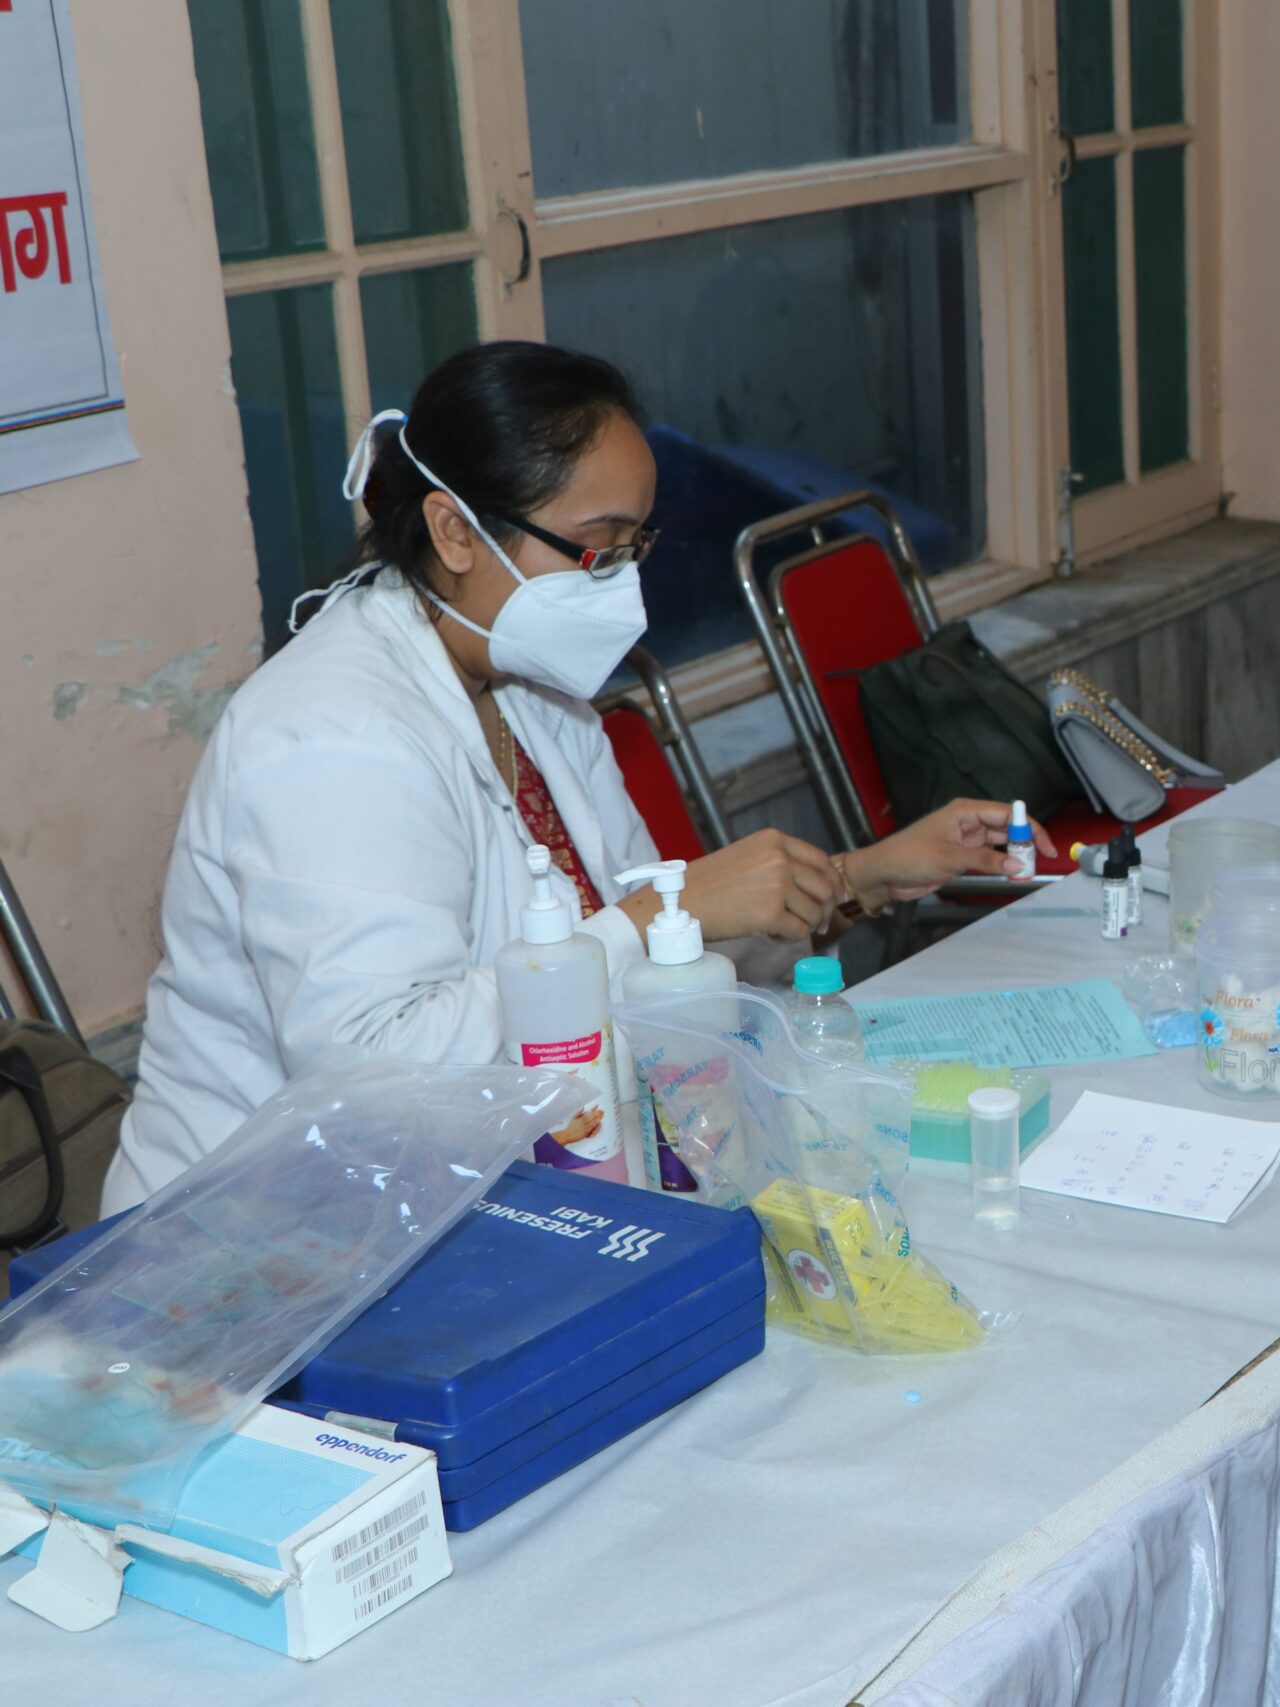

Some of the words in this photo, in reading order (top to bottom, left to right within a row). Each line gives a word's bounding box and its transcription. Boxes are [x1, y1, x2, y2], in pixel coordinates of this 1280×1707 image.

[1215, 990, 1254, 1008] Flora
[1230, 1027, 1268, 1044] Flora
[529, 1045, 567, 1054] Chlorhexidine
[540, 1053, 566, 1062] Antiseptic
[568, 1049, 589, 1059] Solution
[550, 1206, 614, 1228] KABI
[315, 1433, 408, 1464] eppendorf
